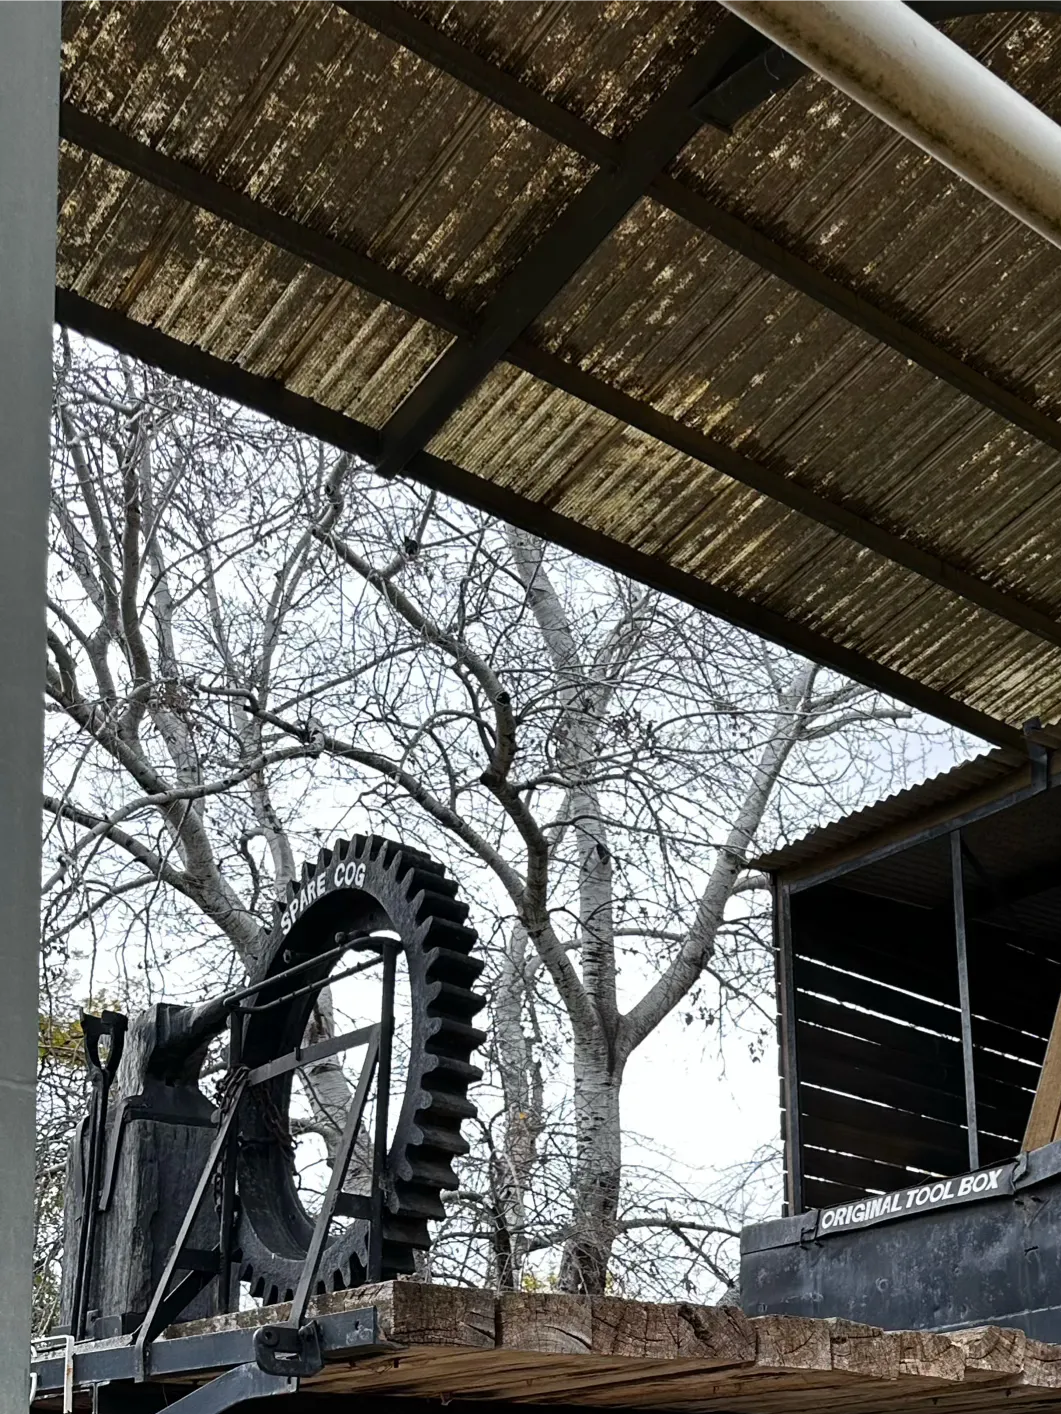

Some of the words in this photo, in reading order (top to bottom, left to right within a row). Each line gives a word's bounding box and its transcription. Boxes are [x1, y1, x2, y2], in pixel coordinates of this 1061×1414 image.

[280, 872, 326, 936] SPARE
[334, 861, 367, 888] COG
[821, 1192, 902, 1229] ORIGINAL
[905, 1183, 954, 1209] TOOL
[957, 1169, 1003, 1195] BOX
